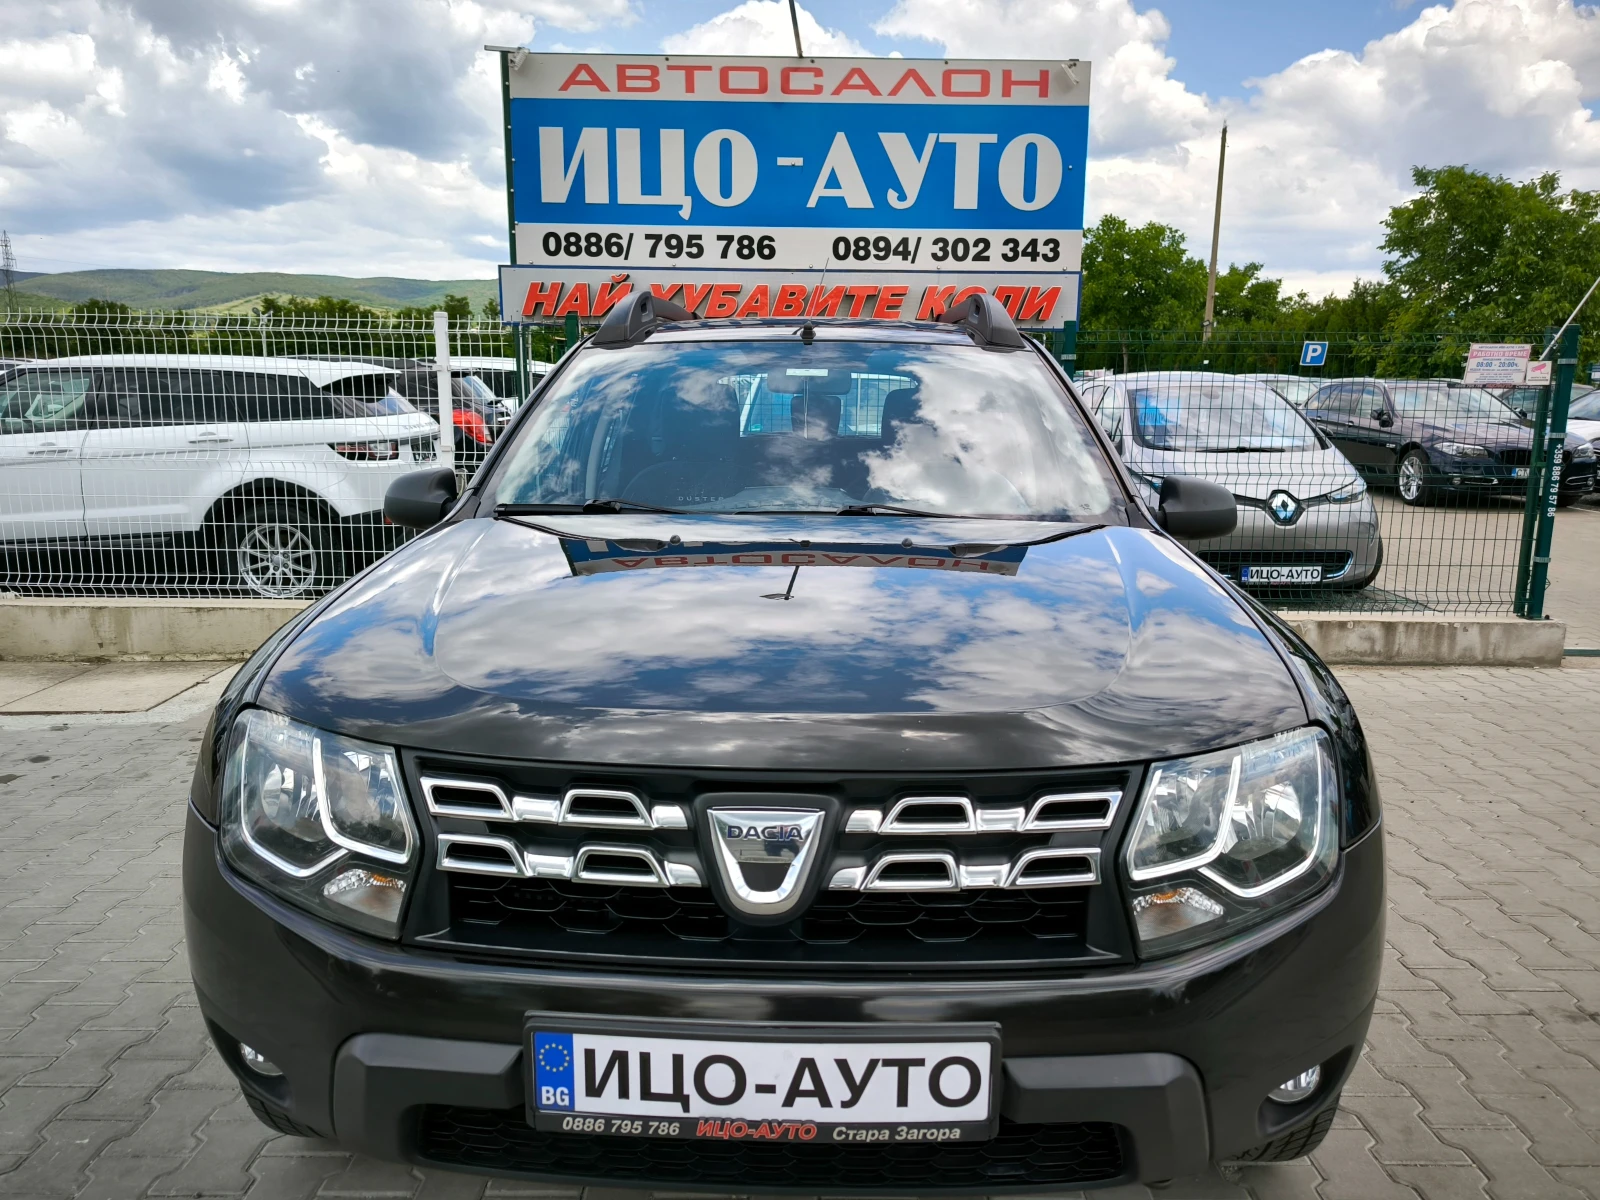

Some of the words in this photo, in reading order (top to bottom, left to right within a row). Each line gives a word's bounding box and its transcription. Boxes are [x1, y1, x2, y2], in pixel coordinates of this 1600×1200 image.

[558, 63, 1050, 98] АВТОСАЛОН
[542, 232, 634, 260] 0886/
[644, 234, 704, 259] 795
[716, 235, 776, 260] 786
[832, 236, 922, 264] 0894/
[930, 237, 991, 262] 302
[1001, 238, 1061, 262] 343
[521, 273, 634, 317] НАЙ
[1305, 344, 1322, 363] P
[1554, 444, 1563, 464] +359
[1552, 465, 1561, 481] 886
[1550, 482, 1559, 493] 79
[1548, 495, 1558, 505] 57
[1547, 507, 1556, 517] 86
[1250, 569, 1320, 581] ИЦО-АУТО
[727, 825, 804, 841] DACIA
[583, 1048, 982, 1113] ИЦО-АУТО
[541, 1086, 570, 1106] BG
[562, 1116, 605, 1132] 0886
[610, 1119, 642, 1135] 795
[648, 1121, 680, 1136] 786
[696, 1119, 817, 1141] ИЦО-АУТО
[832, 1126, 889, 1142] Стара
[895, 1126, 961, 1142] Загора
